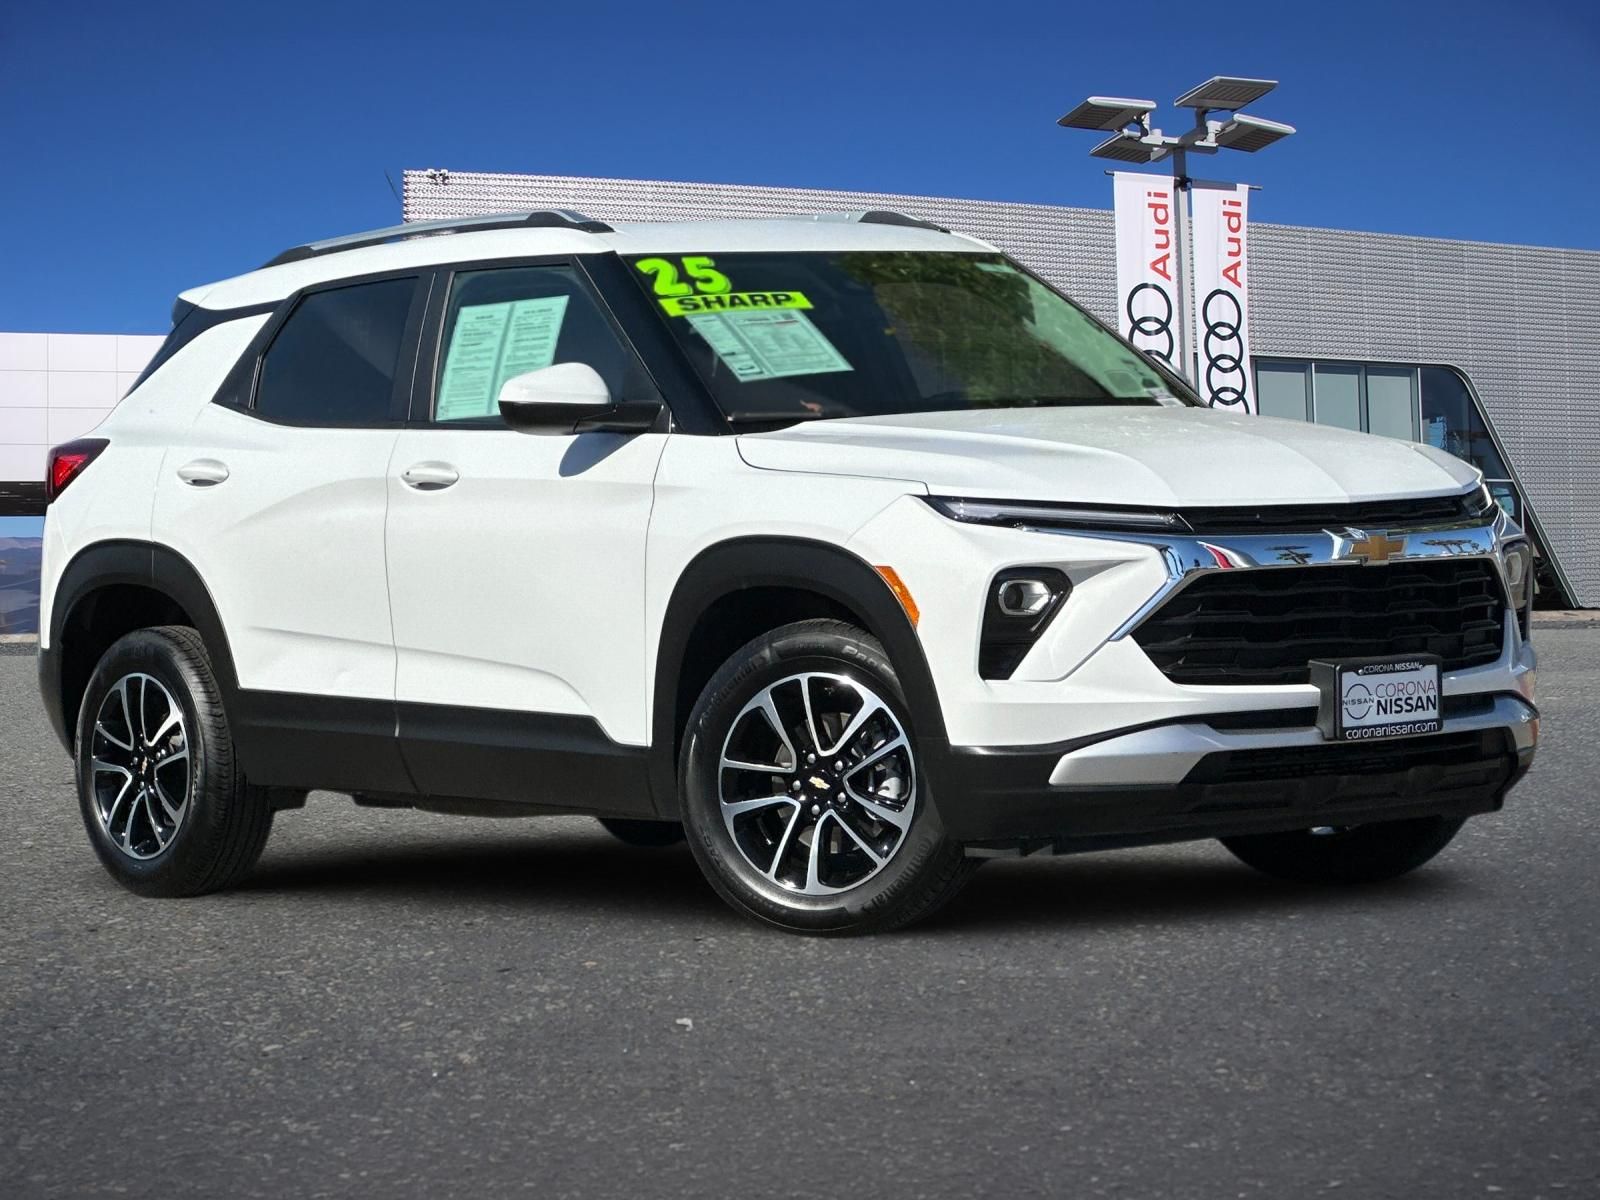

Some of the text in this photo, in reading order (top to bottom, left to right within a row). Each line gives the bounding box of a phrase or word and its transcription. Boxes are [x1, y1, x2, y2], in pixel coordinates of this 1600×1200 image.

[1147, 191, 1172, 282] Audi
[1222, 199, 1242, 289] Audi
[635, 256, 732, 296] 25
[677, 293, 794, 311] SHARP
[1363, 662, 1420, 674] CORONA NISSAN
[1375, 679, 1437, 699] CORONA
[1342, 697, 1374, 706] NISSAN
[1376, 695, 1437, 716] NISSAN
[1346, 721, 1438, 740] coronanissan.com
